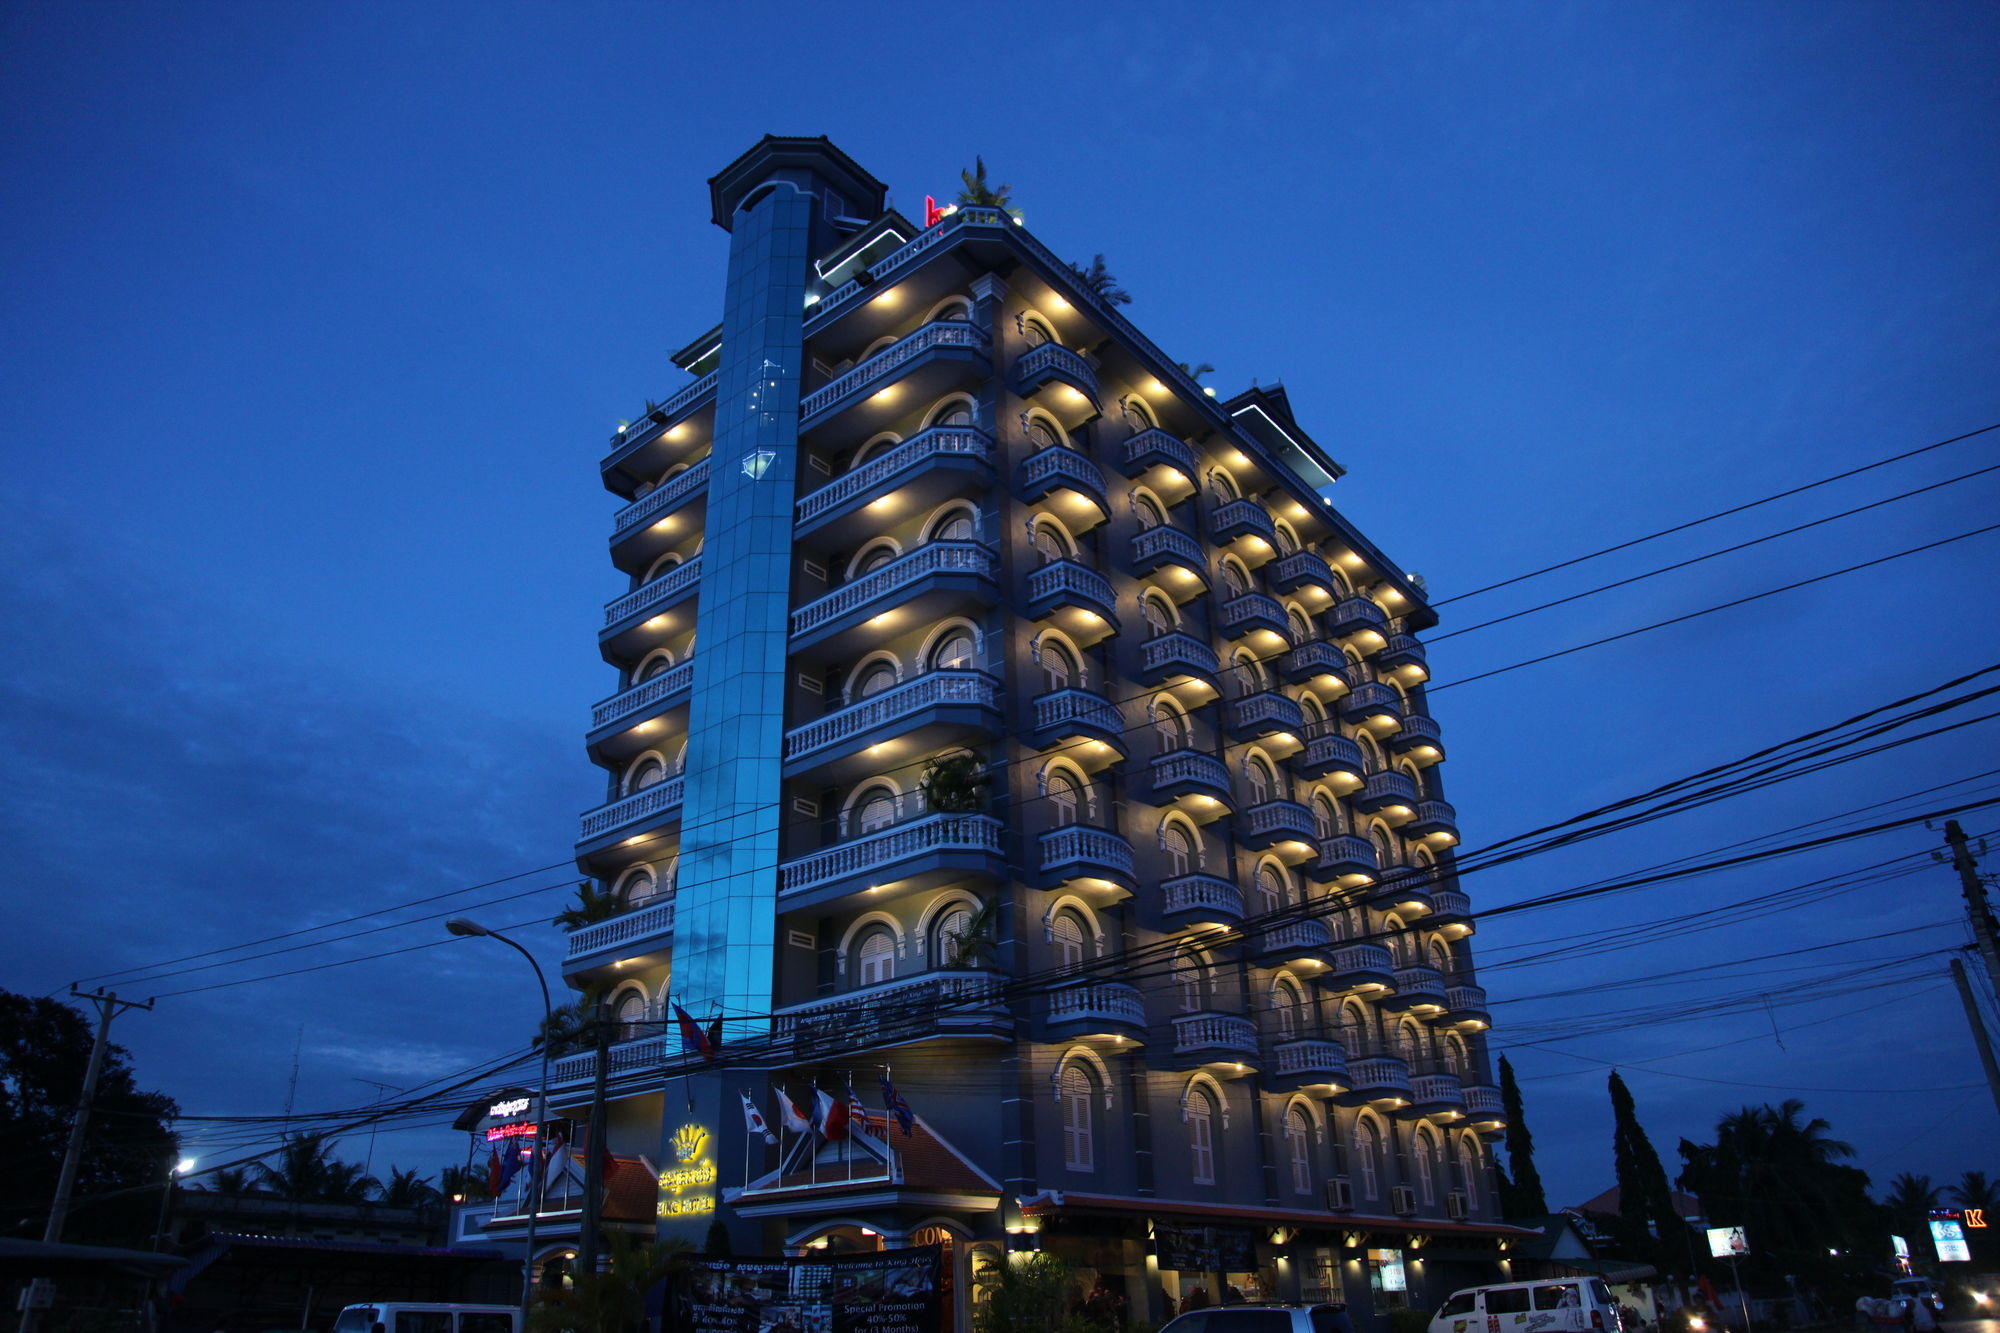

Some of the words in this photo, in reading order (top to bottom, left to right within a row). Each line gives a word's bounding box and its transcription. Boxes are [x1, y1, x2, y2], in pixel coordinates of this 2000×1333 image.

[656, 1200, 679, 1216] KING
[681, 1196, 712, 1212] HOTEL
[1964, 1208, 1988, 1229] K
[837, 1262, 873, 1271] Welcome
[875, 1260, 884, 1268] to
[887, 1258, 907, 1268] King
[844, 1303, 876, 1315] Special
[878, 1302, 925, 1313] Promotion
[866, 1313, 907, 1324] 40%-50%
[882, 1324, 919, 1333] Months)
